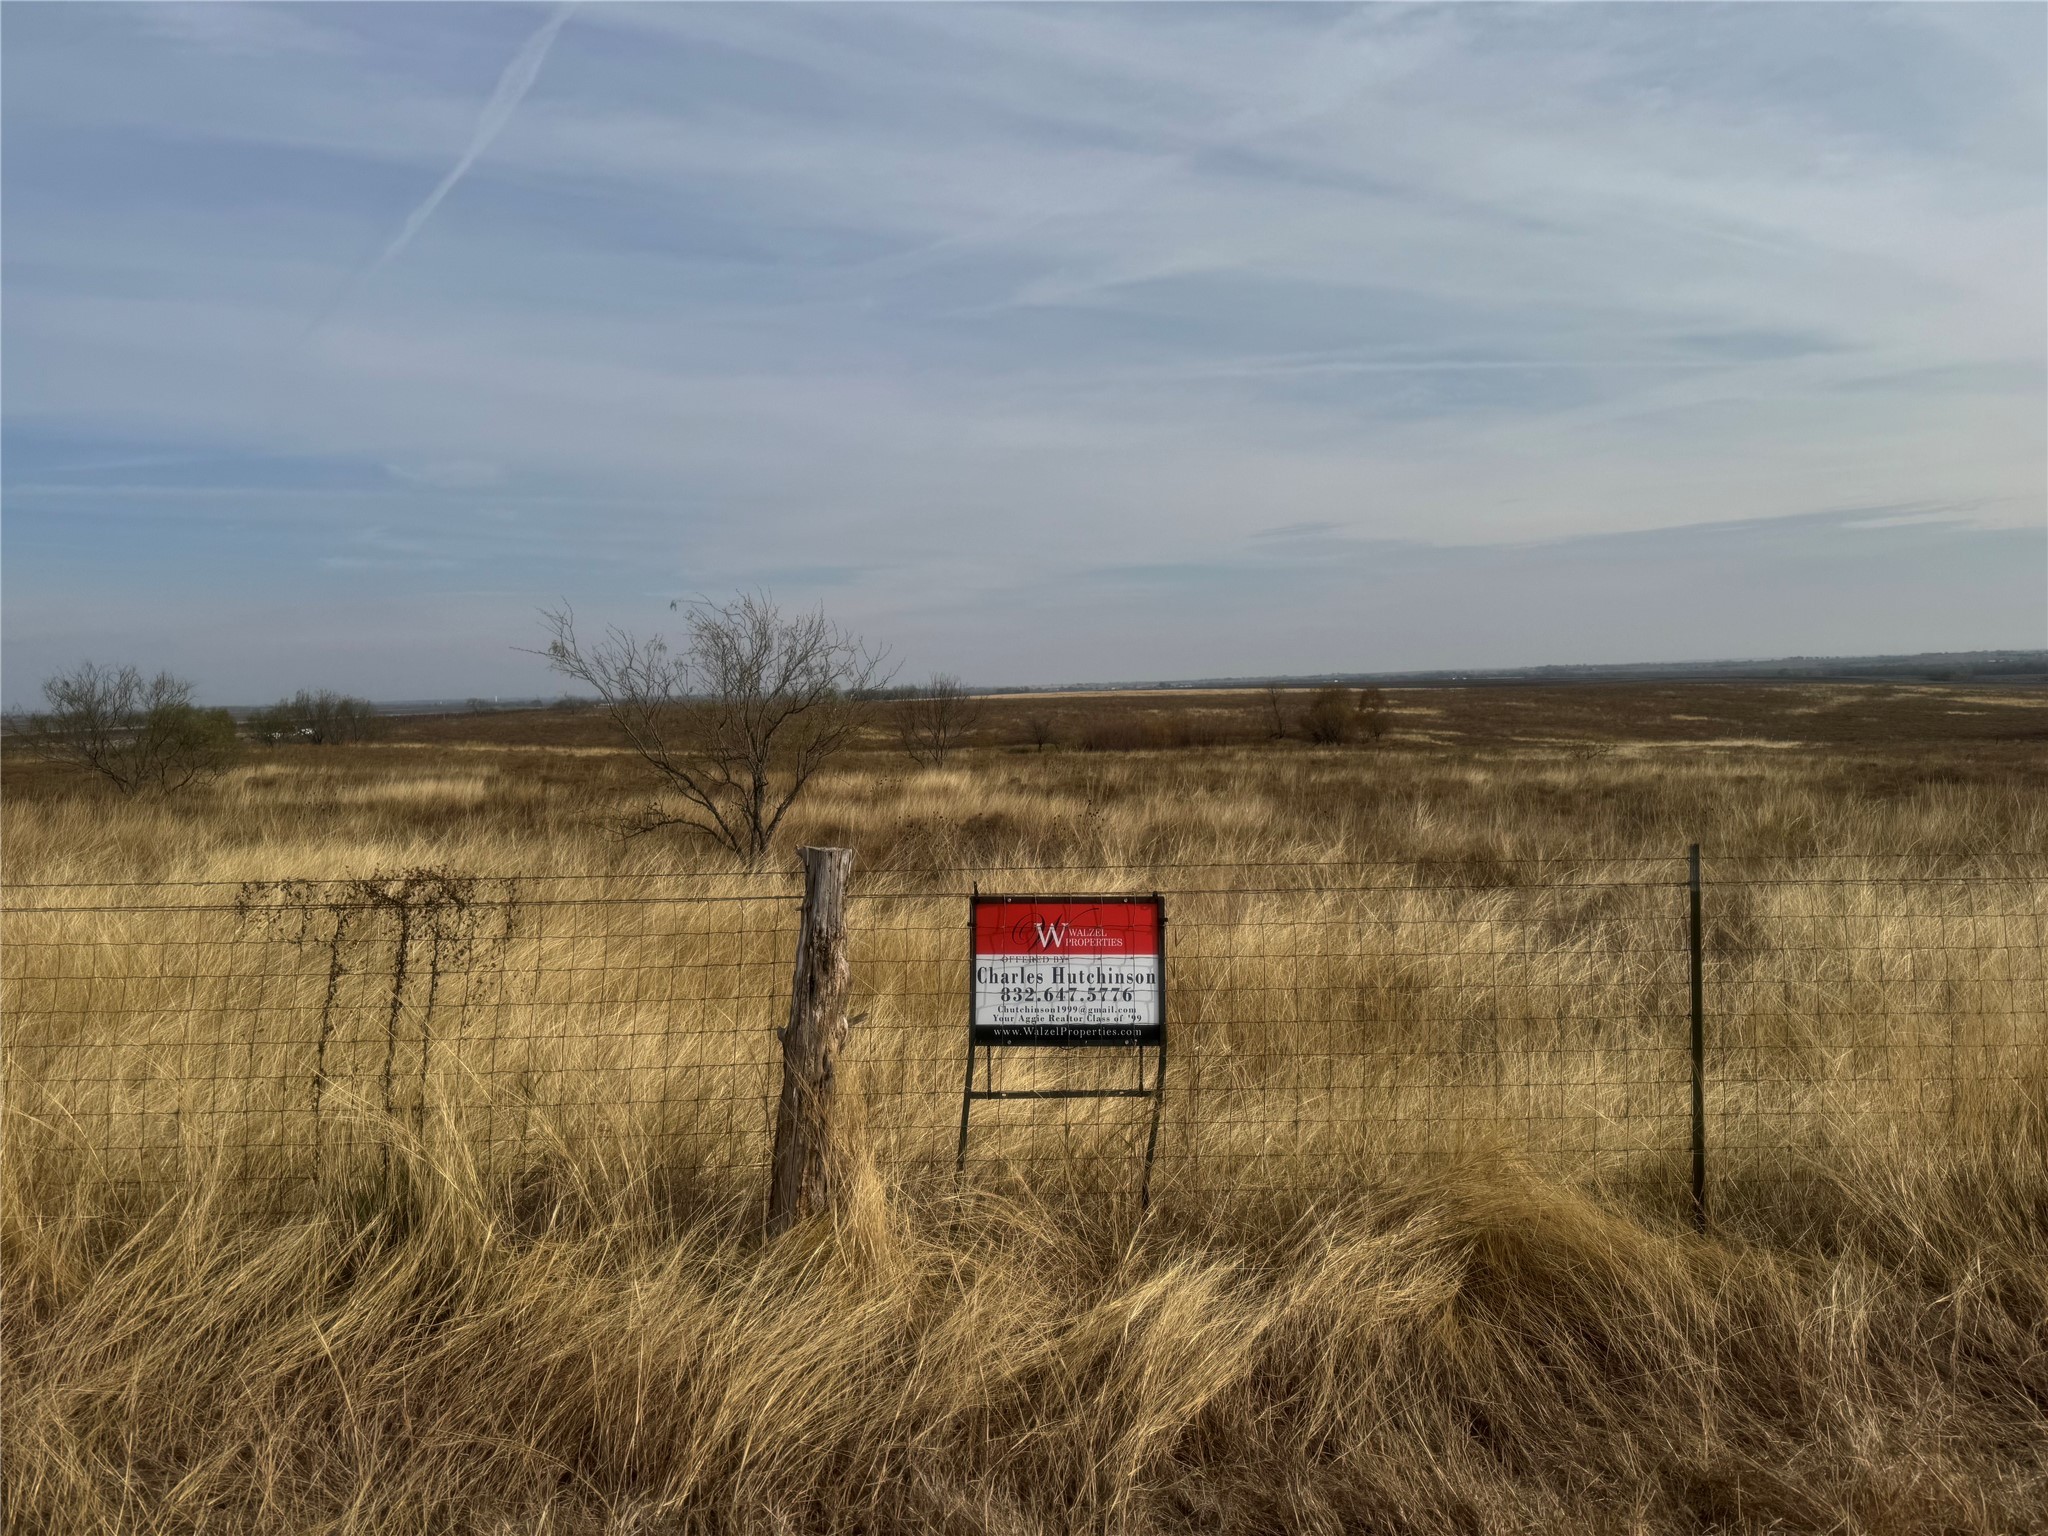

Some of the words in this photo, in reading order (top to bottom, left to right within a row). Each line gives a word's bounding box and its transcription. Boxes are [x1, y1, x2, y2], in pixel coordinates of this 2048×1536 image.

[1068, 928, 1108, 937] WALZEL
[1065, 938, 1123, 947] PROPERTIES
[977, 966, 1044, 984] Charles
[1052, 966, 1156, 984] Hutchinson
[1001, 986, 1133, 1002] 832.647.5776
[997, 1005, 1137, 1014] Chutchinson1999@gmail.com
[993, 1014, 1015, 1022] Your
[1018, 1014, 1045, 1024] Aggie
[1049, 1014, 1083, 1022] Realtor
[1086, 1014, 1111, 1022] Class
[1113, 1014, 1124, 1022] of
[1127, 1014, 1142, 1022] '99
[993, 1026, 1142, 1038] www.WalzelProperties.com
